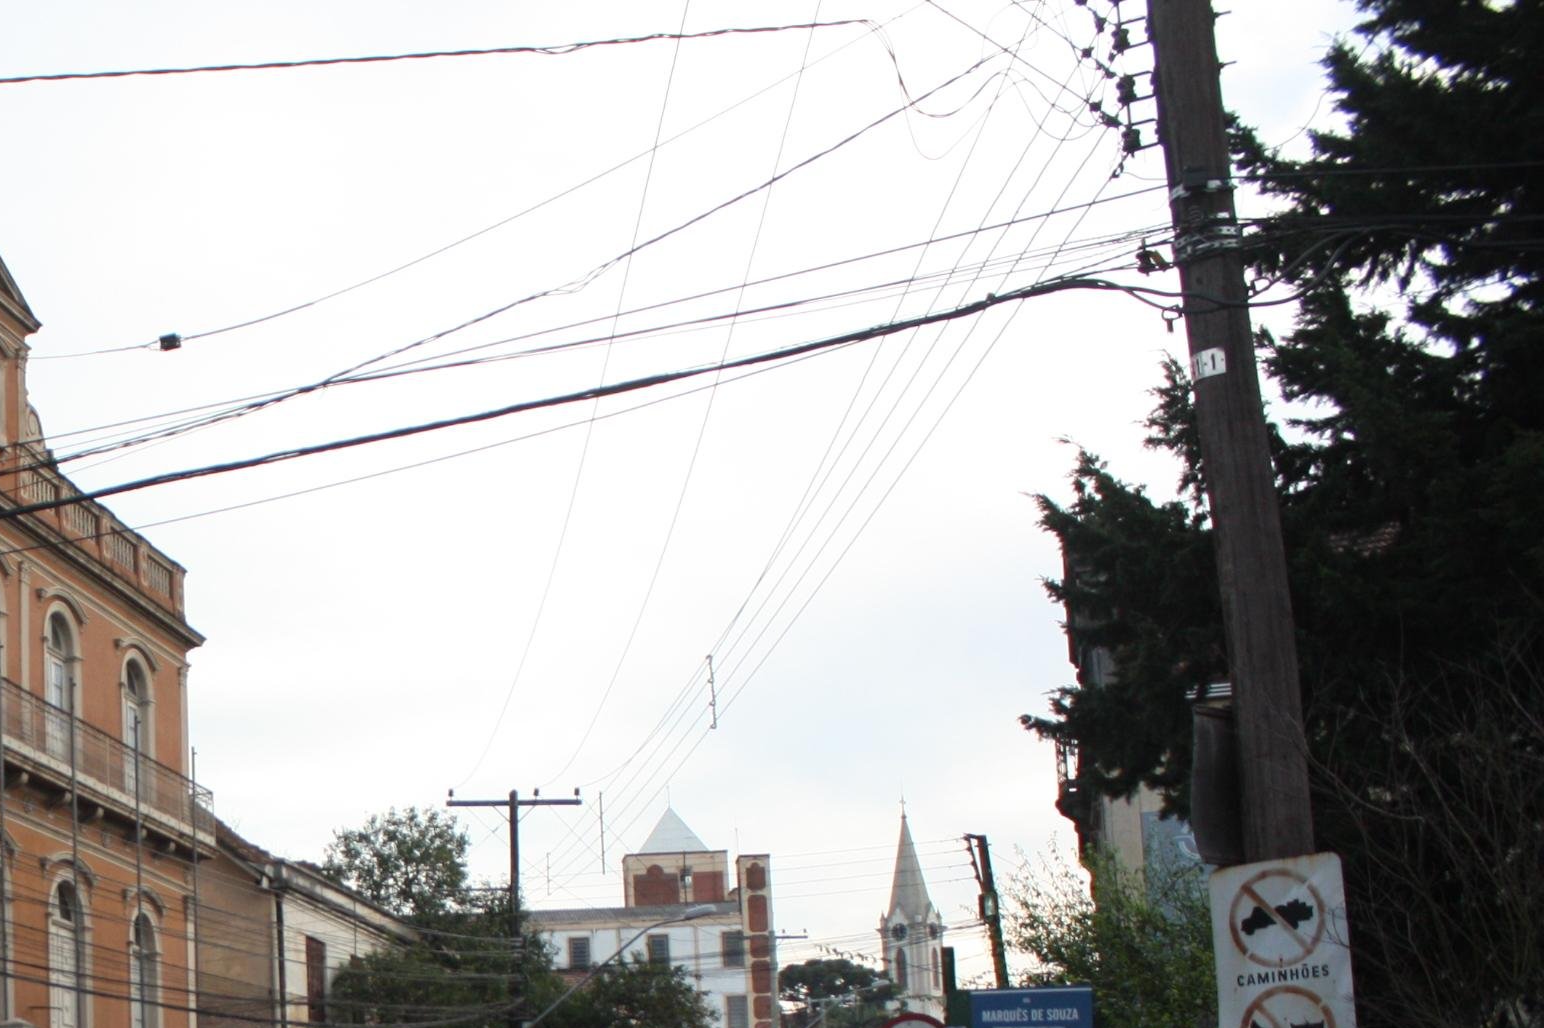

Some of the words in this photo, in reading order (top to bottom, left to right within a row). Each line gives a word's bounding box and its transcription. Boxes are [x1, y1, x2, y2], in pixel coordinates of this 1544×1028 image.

[1237, 964, 1331, 987] CAMINHÕES
[982, 1007, 1029, 1022] MARQUÊS
[1031, 1008, 1045, 1021] DE
[1046, 1008, 1080, 1021] SOUZA
